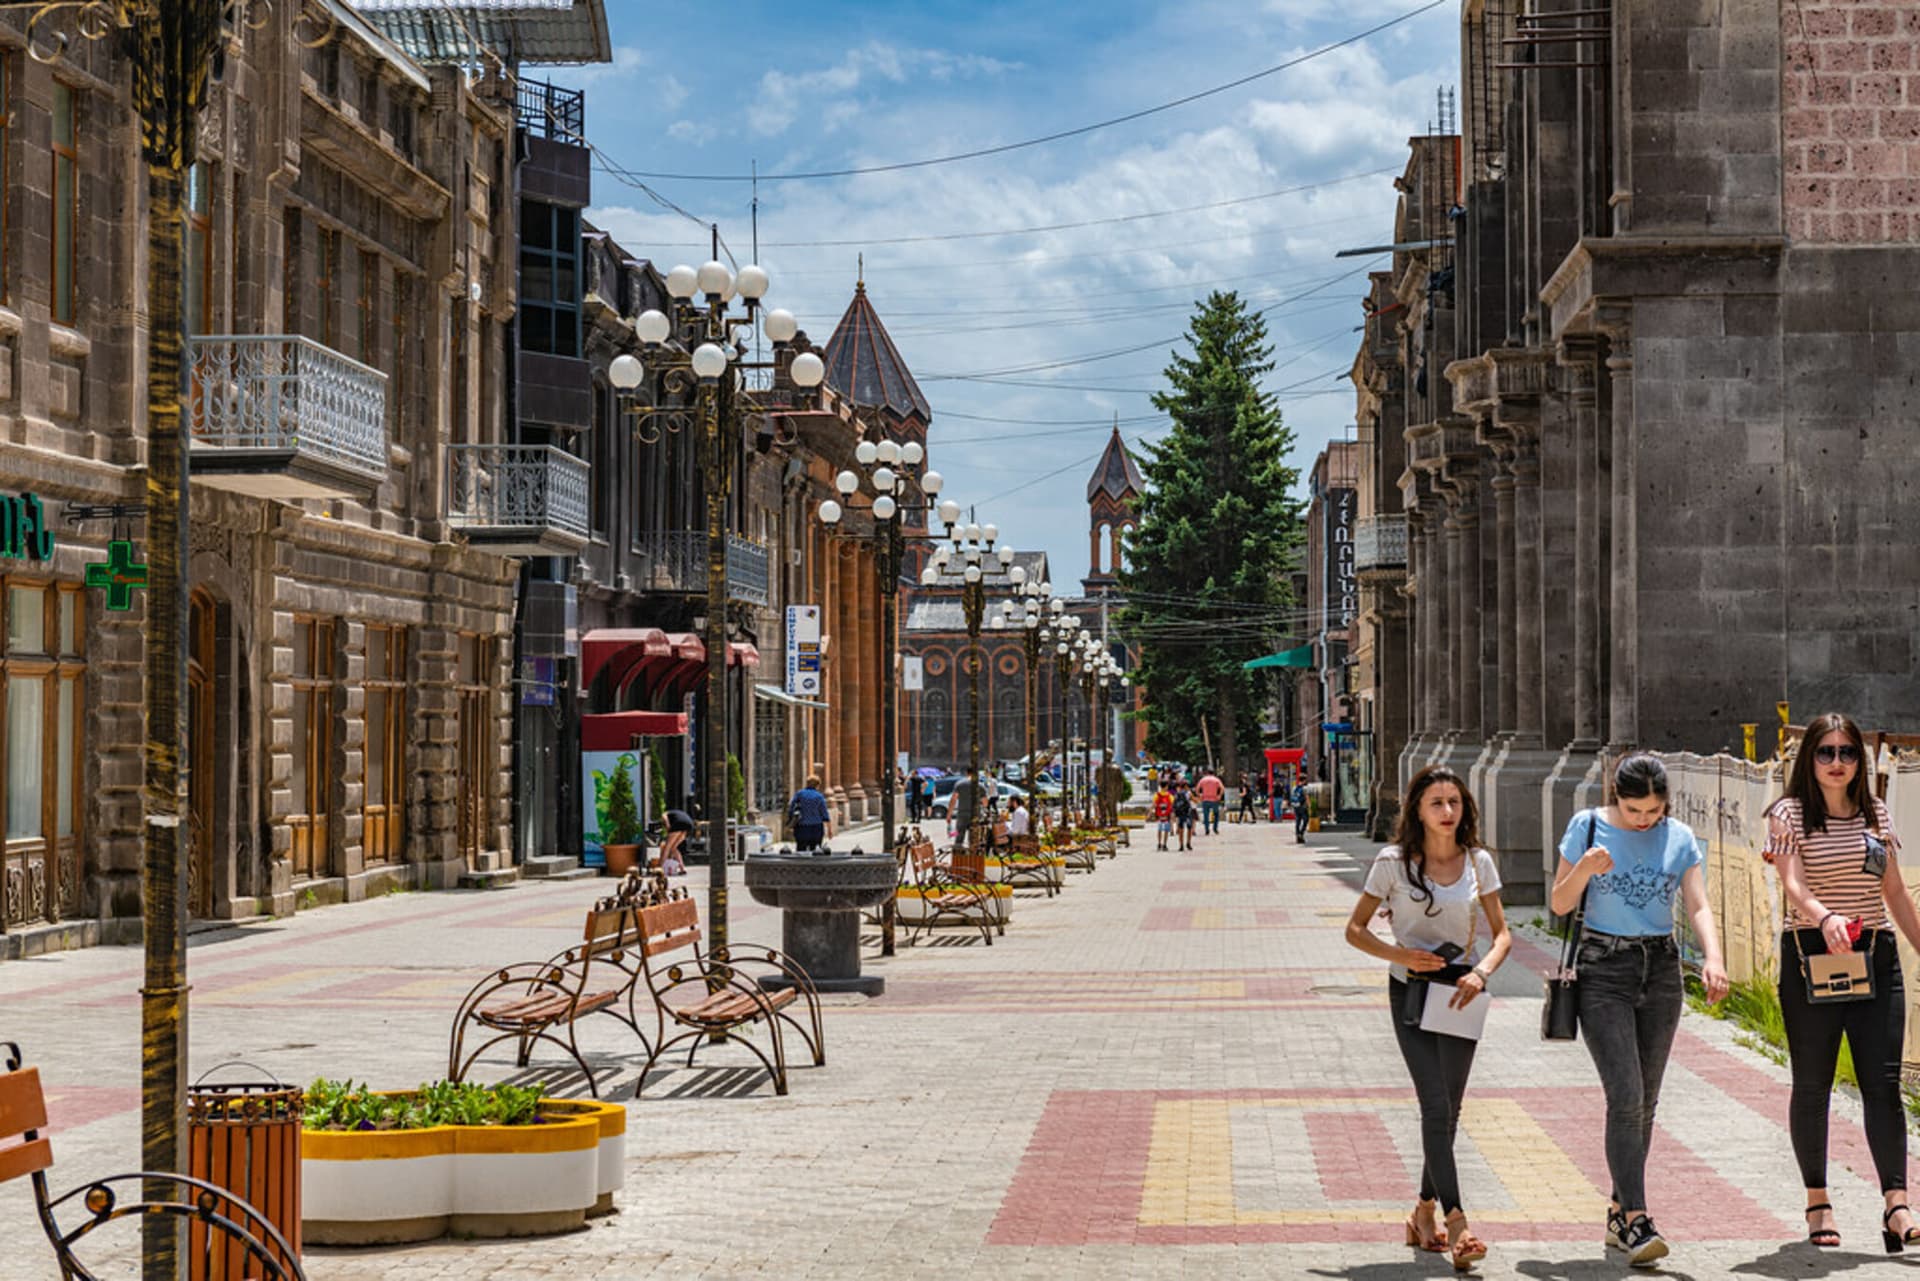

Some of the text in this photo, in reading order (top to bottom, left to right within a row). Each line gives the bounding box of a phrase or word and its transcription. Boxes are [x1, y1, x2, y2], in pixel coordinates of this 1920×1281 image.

[1334, 490, 1355, 627] ՀՅՈՐԱՆՈՑ
[788, 607, 796, 693] COMPUTER SERVICE
